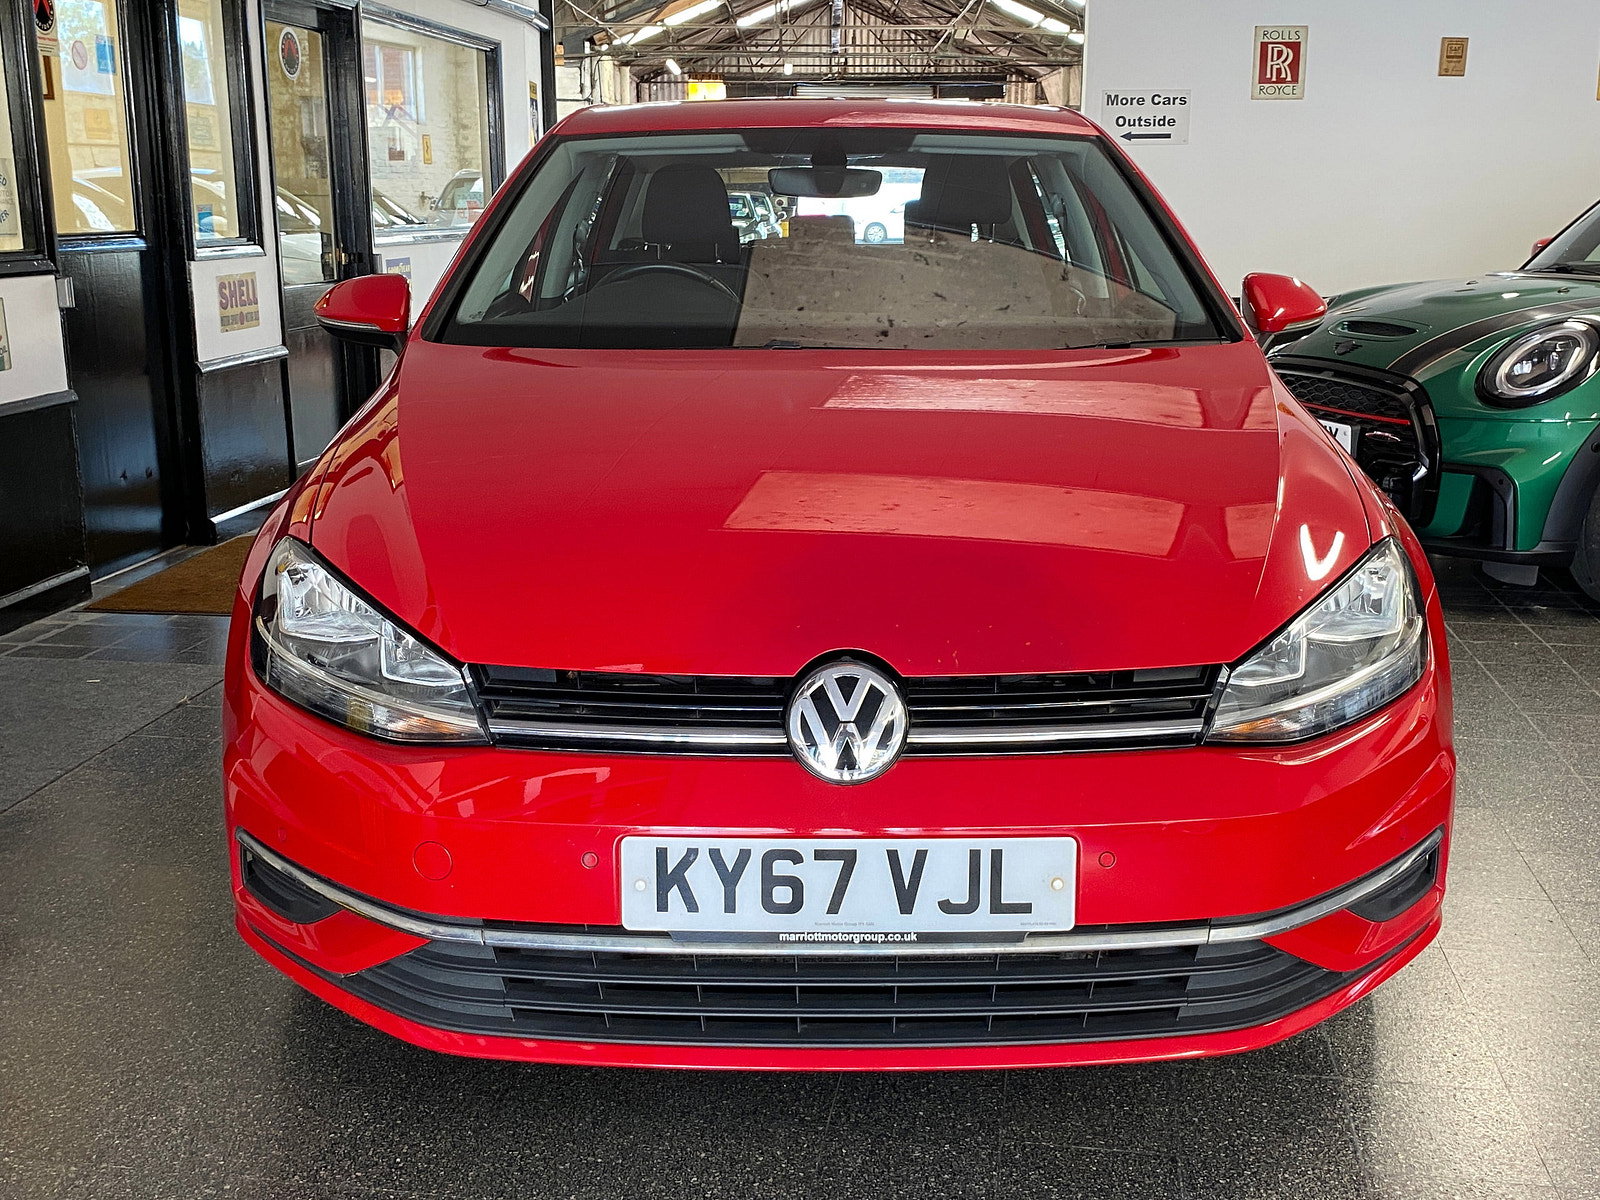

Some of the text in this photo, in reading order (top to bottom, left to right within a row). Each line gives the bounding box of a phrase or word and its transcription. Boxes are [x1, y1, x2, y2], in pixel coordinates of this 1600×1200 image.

[1262, 30, 1301, 40] ROLLS
[1258, 85, 1297, 95] ROYCE
[1106, 93, 1188, 106] More Cars
[1115, 115, 1176, 128] Outside
[218, 278, 259, 310] SHELL
[655, 846, 1033, 916] KY67 VJL
[779, 931, 918, 943] marriottmotorgroup.co.uk
